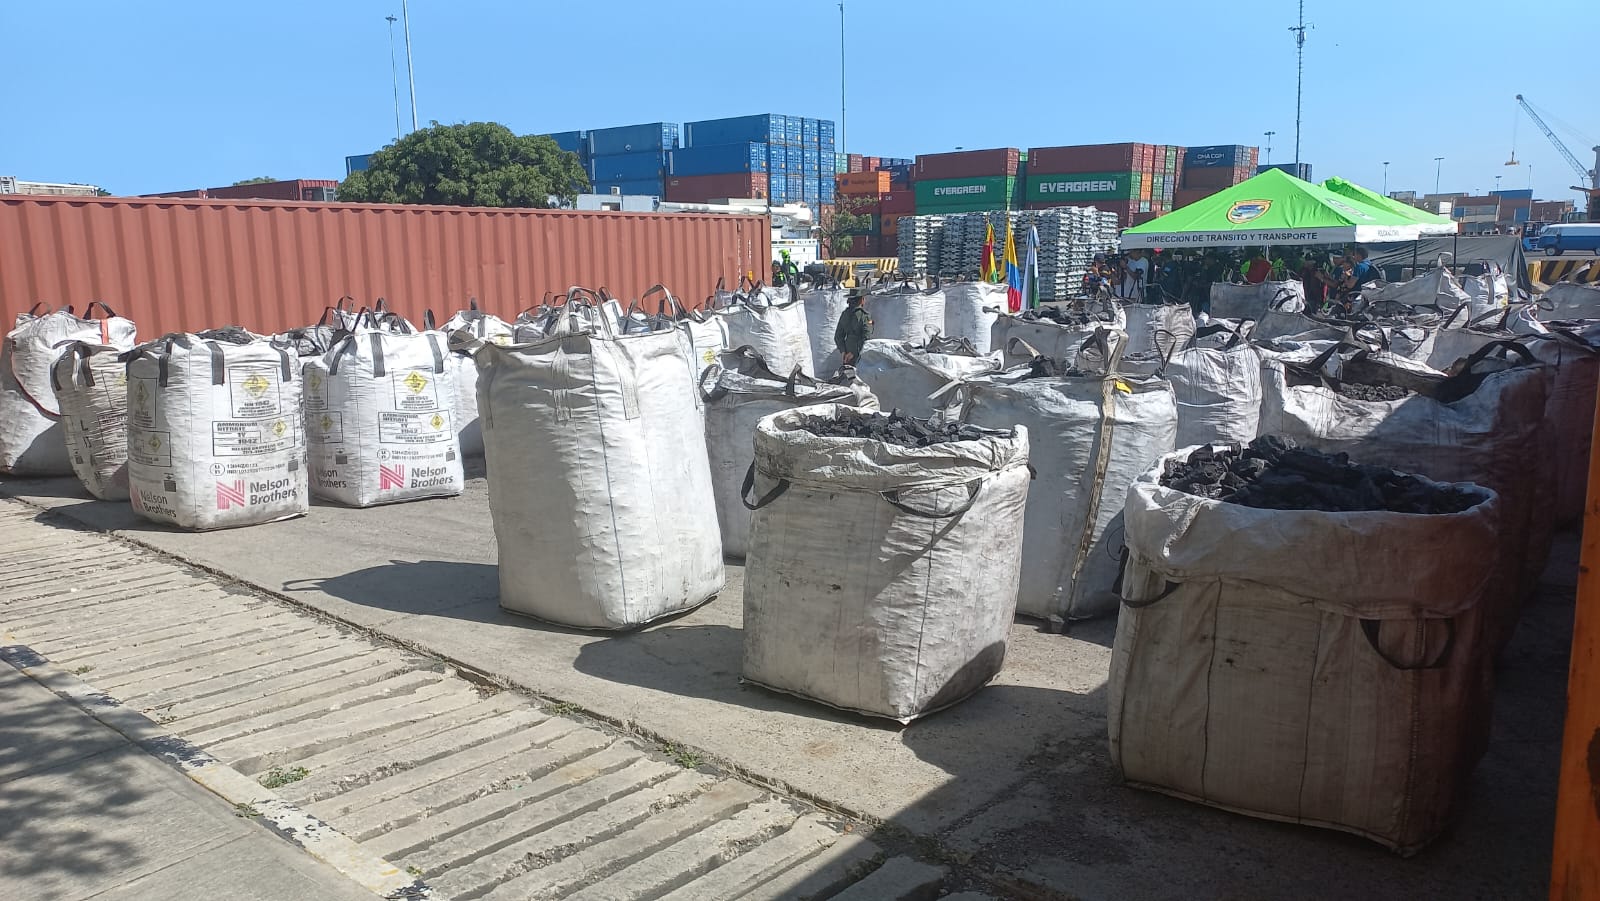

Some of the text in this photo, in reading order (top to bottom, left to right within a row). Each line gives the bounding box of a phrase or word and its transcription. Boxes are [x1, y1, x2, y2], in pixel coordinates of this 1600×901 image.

[934, 185, 986, 195] EVERGREEN
[1039, 180, 1117, 193] EVERGREEN
[1257, 232, 1318, 240] TRANSPORTE
[411, 466, 447, 478] Nelson
[250, 478, 289, 493] Nelson
[410, 475, 453, 488] Brothers
[140, 489, 168, 505] Nelson
[250, 487, 297, 505] Brothers
[143, 502, 177, 518] Brothers
